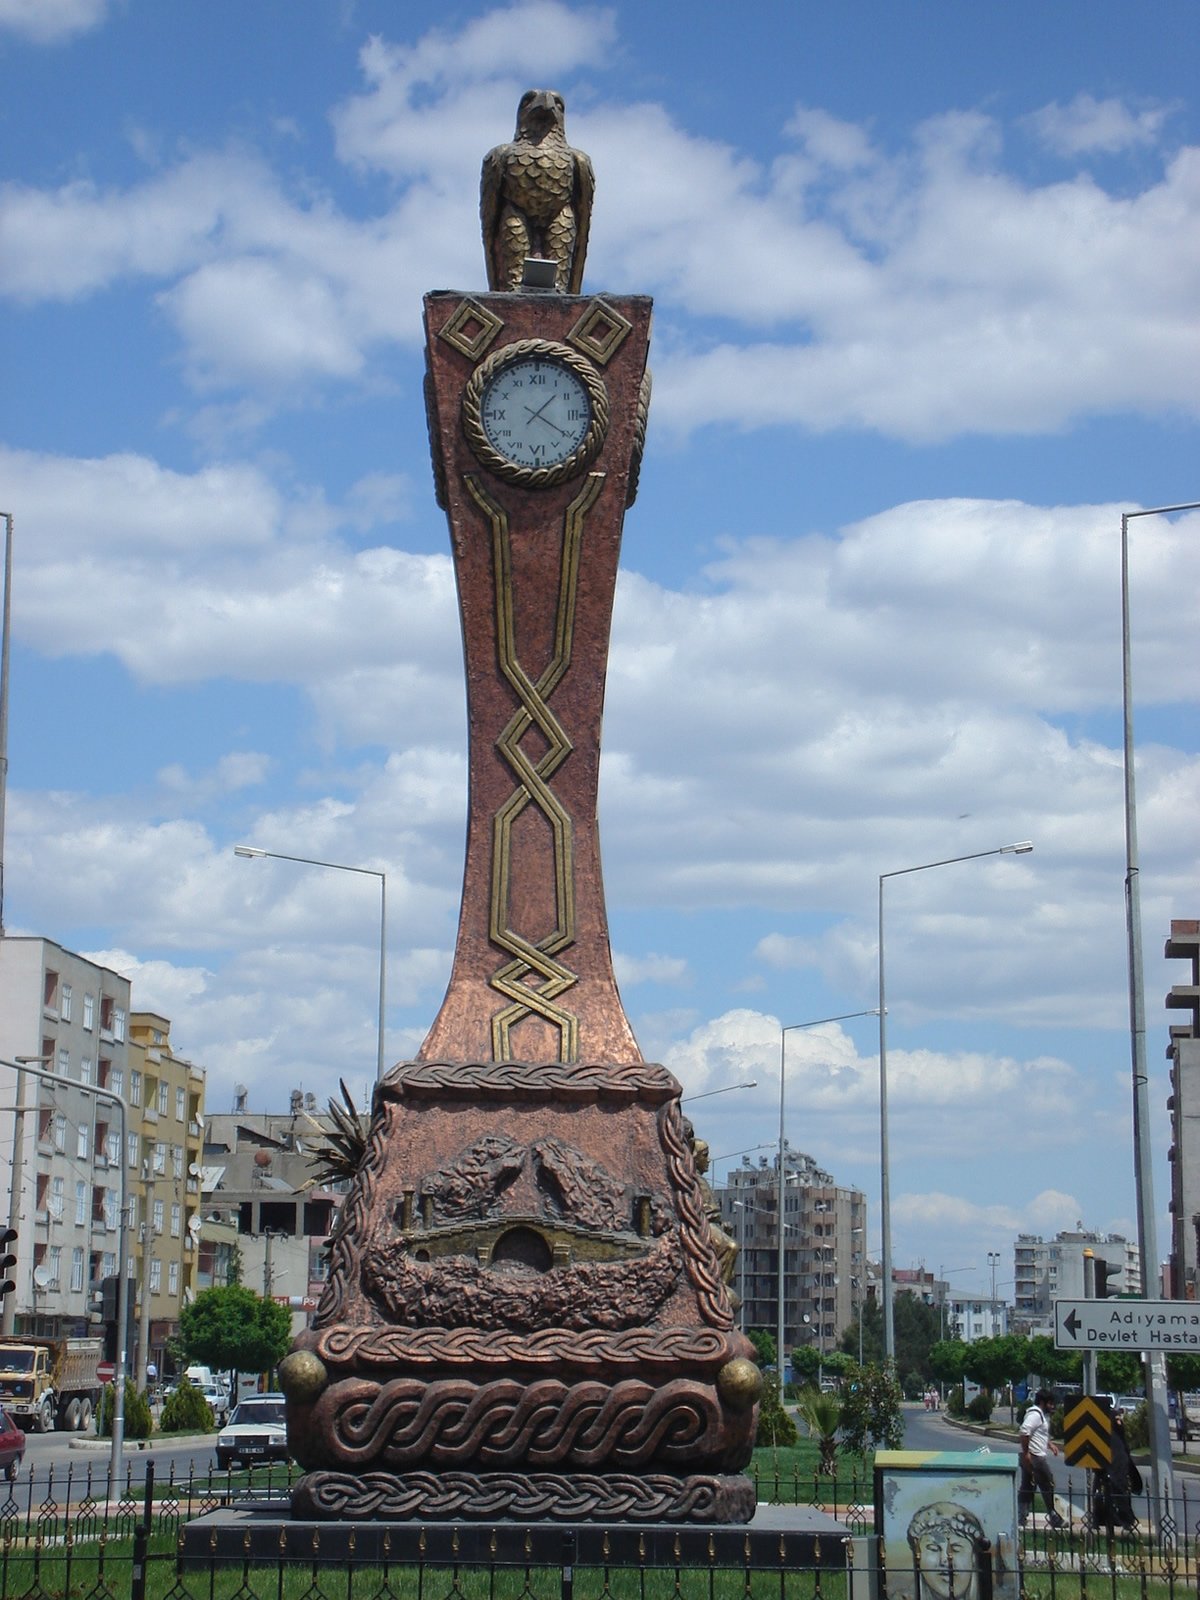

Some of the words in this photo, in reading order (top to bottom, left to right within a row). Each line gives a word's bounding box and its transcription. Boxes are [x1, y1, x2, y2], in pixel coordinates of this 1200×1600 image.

[529, 375, 546, 385] XII
[501, 392, 509, 400] X
[493, 409, 506, 421] IX
[567, 409, 579, 421] III
[528, 445, 545, 456] VI
[1087, 1328, 1138, 1343] Devlet
[1150, 1330, 1200, 1344] Hasta
